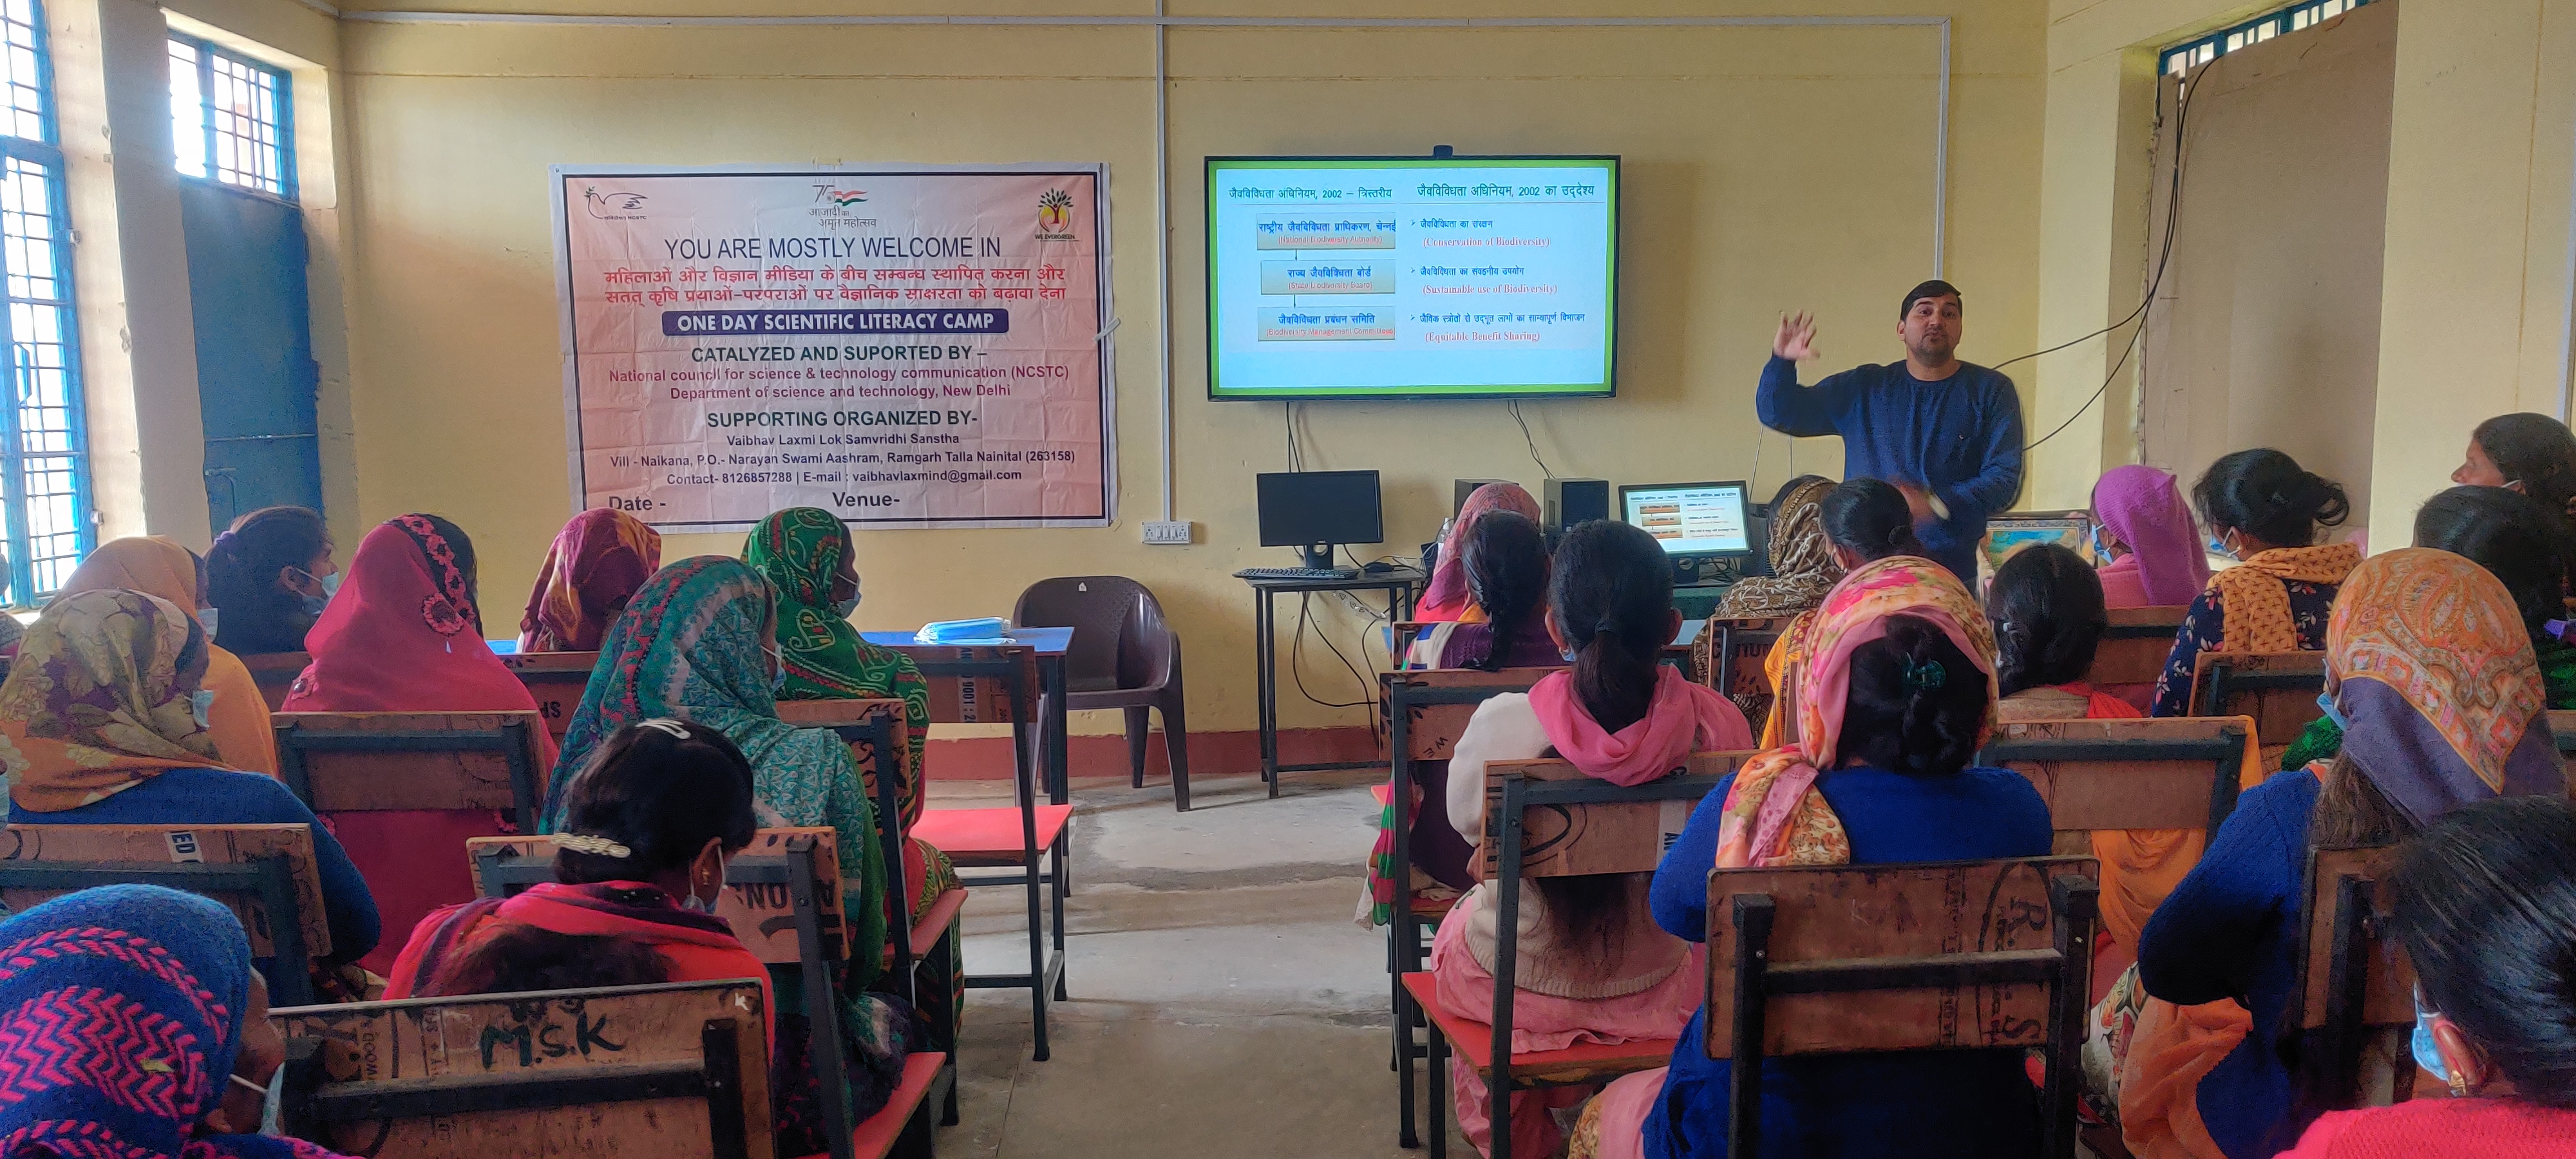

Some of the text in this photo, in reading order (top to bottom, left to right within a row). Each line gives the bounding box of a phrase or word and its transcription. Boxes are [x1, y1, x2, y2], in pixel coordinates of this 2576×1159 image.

[1229, 187, 1274, 199] जैवविविधता
[1278, 187, 1318, 200] अधिनियम,
[1358, 187, 1392, 198] त्रिस्तरीय
[1417, 183, 1466, 197] जैवविविधता
[1471, 183, 1513, 197] अधिनियम,
[1519, 187, 1540, 196] 2002
[1546, 185, 1557, 196] का
[844, 216, 876, 228] महोत्सव
[1258, 221, 1283, 234] राष्ट्रीय
[1288, 221, 1330, 232] जैवविविधता
[1334, 221, 1371, 232] प्राधिकरण,
[1421, 218, 1457, 228] जैवविविधता
[1311, 236, 1348, 244] Biodiversity
[1423, 236, 1550, 247] (Conservation of Biodiversity)
[665, 237, 999, 259] YOU ARE MOSTLY WELCOME IN
[604, 265, 672, 283] महिलाओं
[679, 266, 708, 285] और
[713, 266, 760, 283] विज्ञान
[764, 265, 814, 281] मीडिया
[820, 265, 835, 280] के
[839, 265, 867, 281] बीच
[931, 263, 985, 280] स्थापित
[990, 269, 1030, 279] करना
[1037, 263, 1065, 279] और
[1309, 267, 1352, 278] जैवविविधता
[1421, 266, 1456, 276] जैवविविधता
[1459, 267, 1468, 276] का
[1311, 281, 1348, 290] Biodiversity
[1423, 285, 1475, 294] (Sustainable
[1493, 285, 1502, 294] of
[1503, 284, 1557, 295] Biodiversity)
[605, 292, 645, 306] सतत्
[648, 286, 679, 306] कृषि
[817, 289, 834, 300] पर
[837, 284, 899, 301] वैज्ञानिक
[904, 288, 961, 300] साक्षरता
[969, 283, 987, 299] को
[1039, 283, 1066, 299] देना
[677, 313, 994, 332] ONE DAY SCIENTIFIC LITERACY CAMP
[1278, 314, 1321, 325] जैवविविधता
[1351, 313, 1376, 324] समिति
[1517, 314, 1525, 322] का
[1425, 331, 1540, 343] (Equitable Benefit Sharing)
[692, 347, 795, 362] CATALYZED
[801, 346, 838, 361] AND
[844, 346, 942, 360] SUPORTED
[949, 346, 972, 359] BY
[610, 365, 1068, 381] National council for science & technology communication (NCSTC)
[671, 384, 1010, 400] Department of science and technology, New Delhi
[708, 411, 827, 427] SUPPORTING
[834, 411, 941, 426] ORGANIZED
[727, 433, 959, 445] Vaibhav Laxmi Lok Samvridhi Sanstha
[611, 457, 629, 467] Vill
[641, 456, 692, 466] Naikana,
[729, 454, 778, 466] Narayan
[782, 453, 822, 463] Swami
[826, 453, 882, 464] Aashram,
[887, 452, 941, 464] Ramgarh
[945, 451, 972, 462] Talla
[978, 451, 1021, 461] Nainital
[1026, 451, 1074, 464] (263158)
[667, 474, 718, 484] Contact-
[723, 472, 791, 483] 8126857288
[804, 471, 840, 482] E-mail
[608, 496, 652, 511] Date
[833, 492, 900, 507] Venue-
